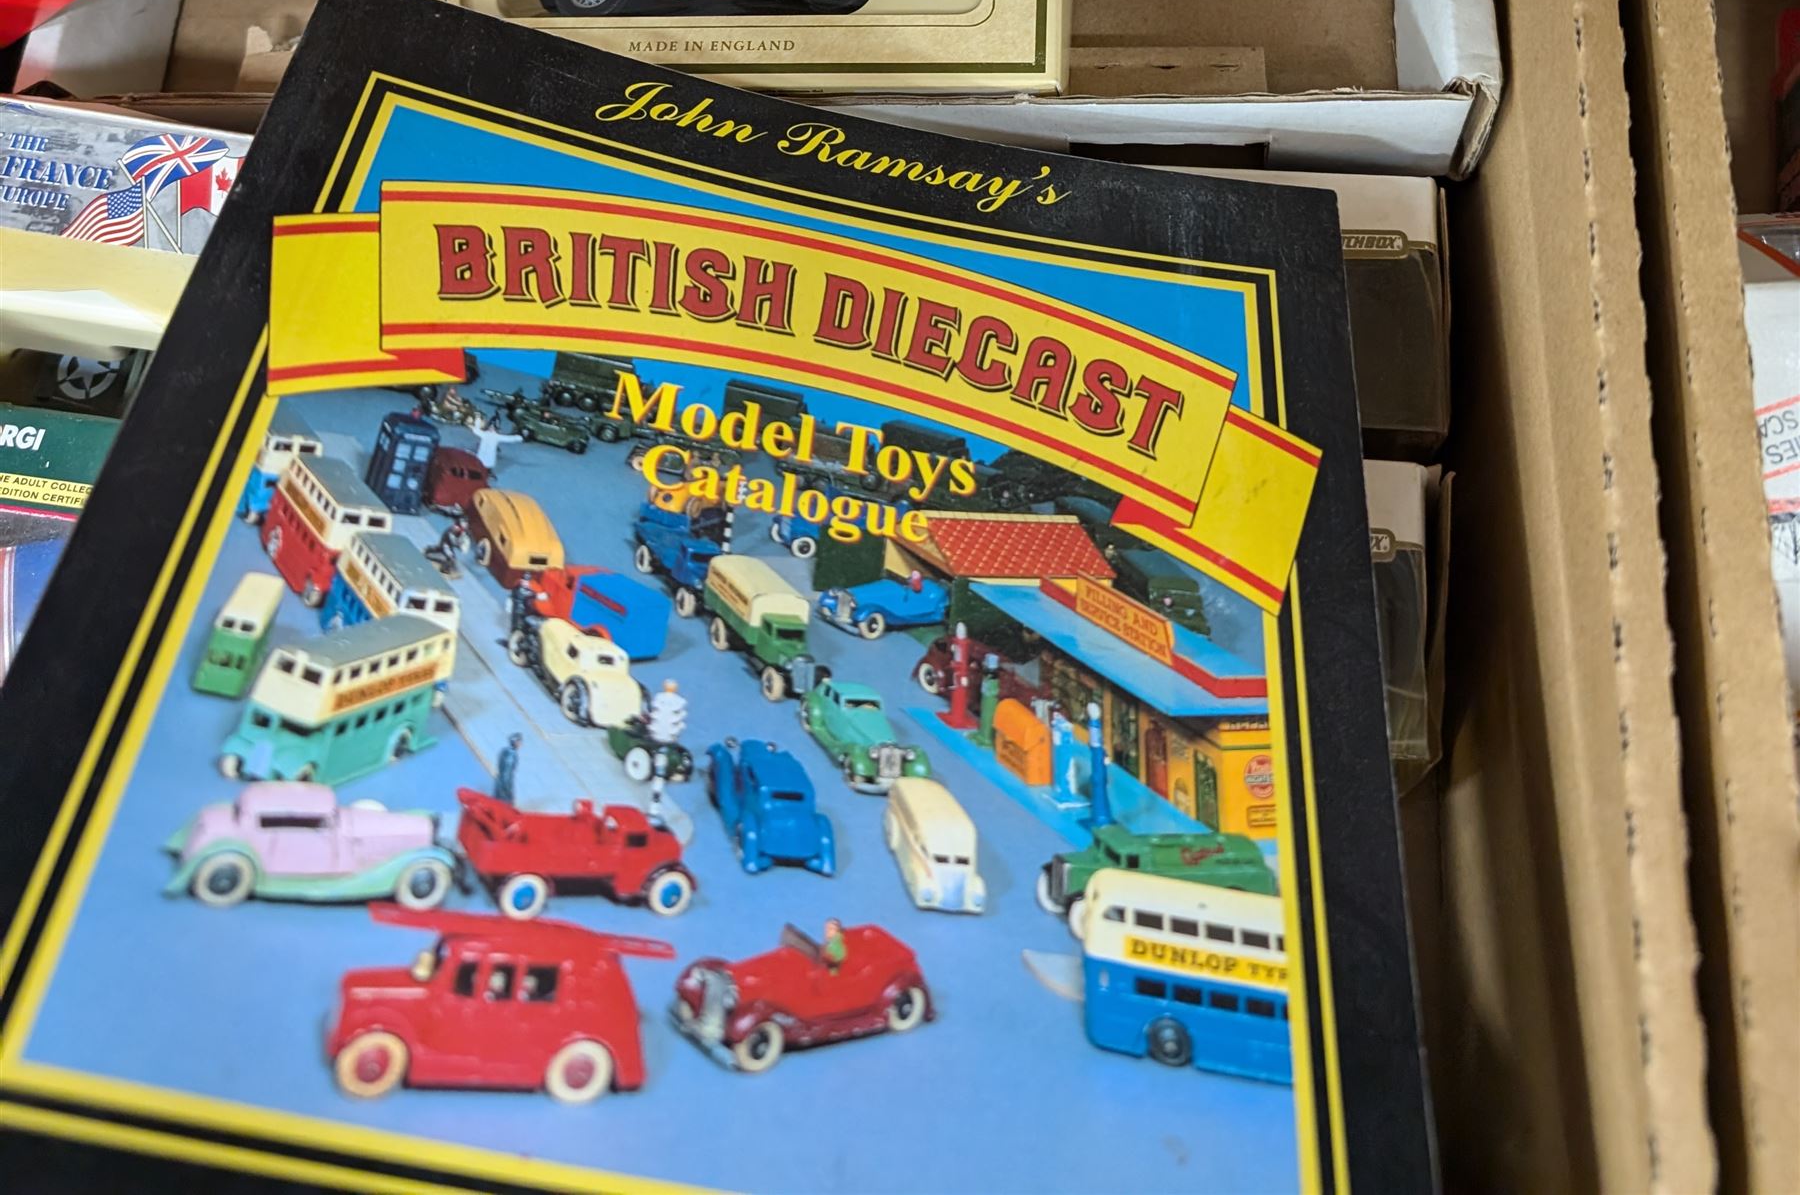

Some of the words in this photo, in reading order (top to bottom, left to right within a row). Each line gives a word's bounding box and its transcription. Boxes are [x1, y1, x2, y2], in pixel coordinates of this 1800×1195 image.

[628, 40, 678, 52] MADE
[685, 40, 704, 51] IN
[710, 39, 796, 52] ENGLAND
[8, 132, 49, 154] THE
[595, 81, 768, 144] John
[777, 122, 1074, 214] Ramsay's
[0, 155, 114, 191] FRANCE
[0, 184, 71, 210] UROPE
[433, 224, 798, 337] BRITISH
[813, 272, 1185, 459] DIECAST
[0, 424, 46, 451] RGI
[603, 370, 817, 464] Model
[836, 421, 977, 501] Toys
[13, 476, 48, 488] ADULT
[642, 444, 930, 543] Catalogue
[1131, 938, 1237, 973] DUNLOP
